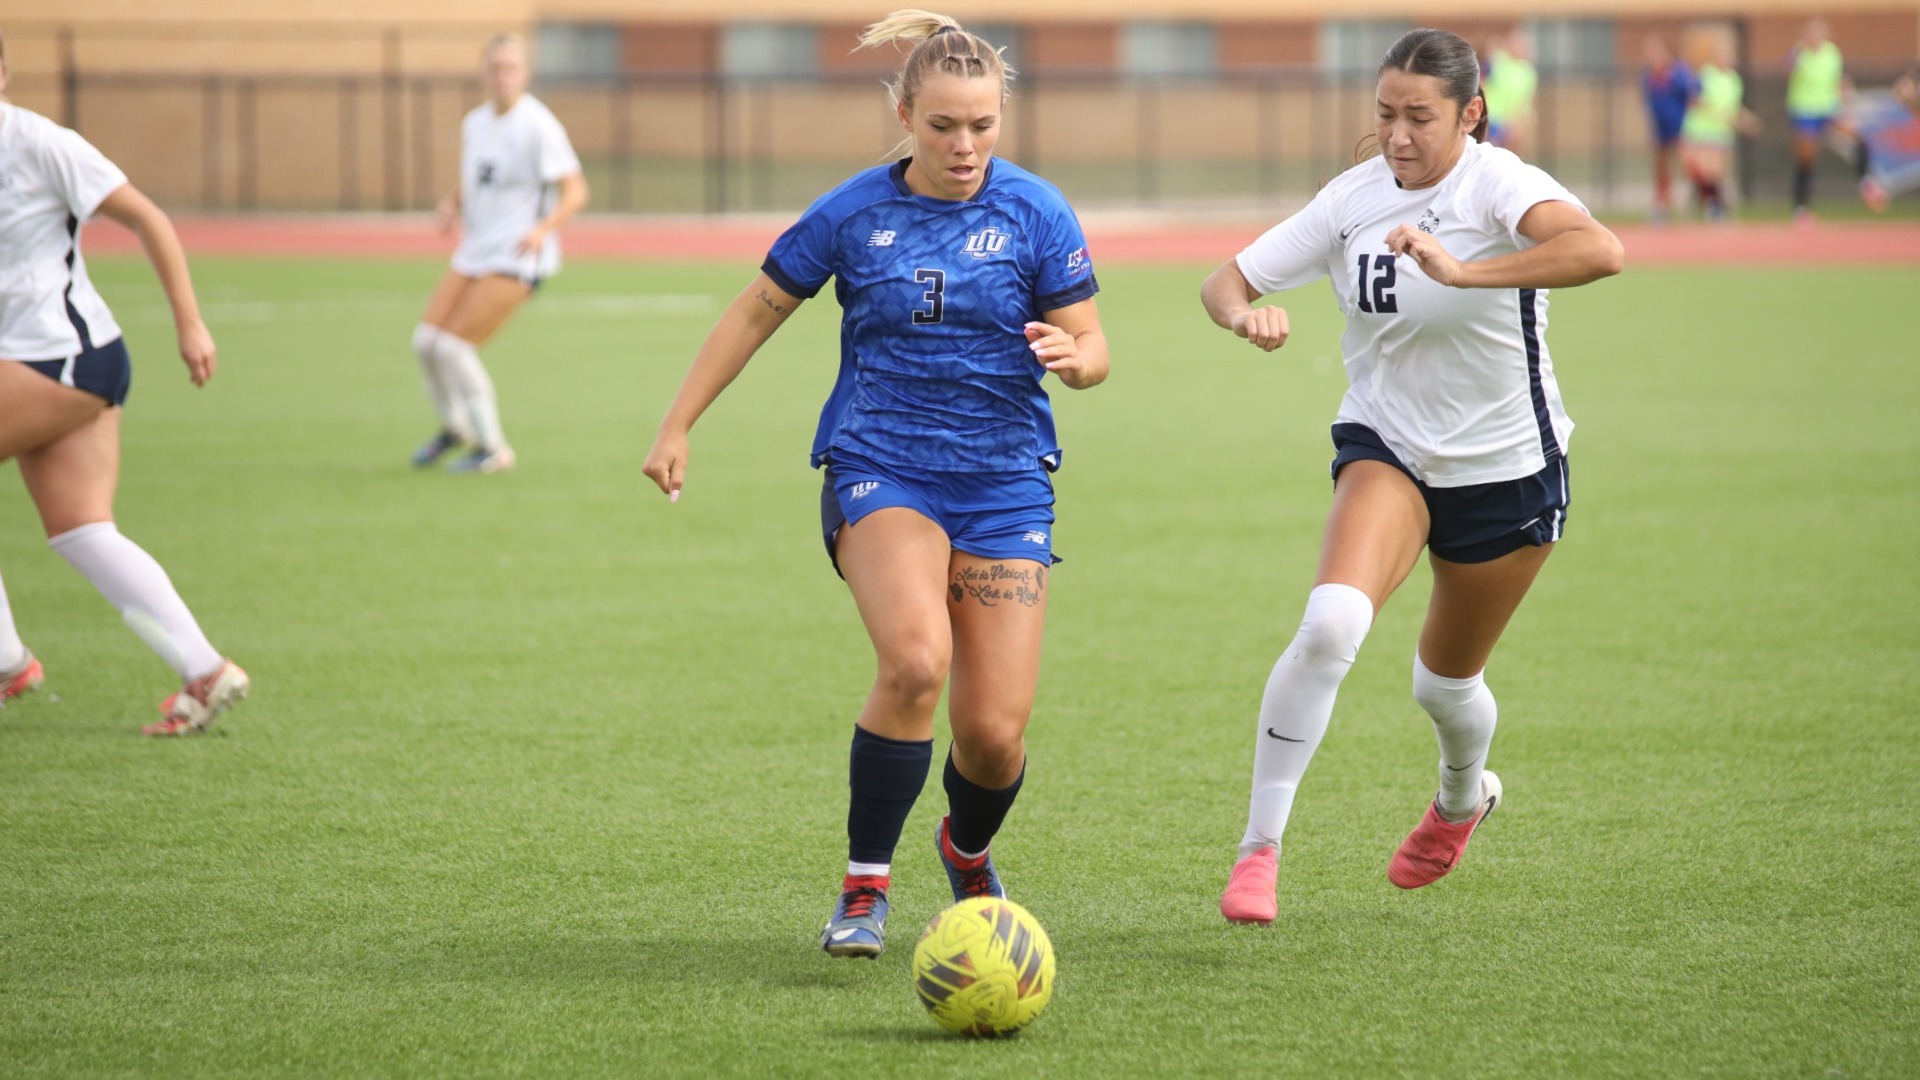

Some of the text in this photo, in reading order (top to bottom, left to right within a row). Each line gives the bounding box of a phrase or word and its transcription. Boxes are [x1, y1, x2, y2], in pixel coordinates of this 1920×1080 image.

[960, 226, 1012, 260] LCU
[912, 268, 946, 324] 3
[1357, 253, 1398, 313] 12
[956, 564, 1033, 588] Love is Patient
[969, 584, 1001, 607] Love
[1004, 590, 1014, 600] is
